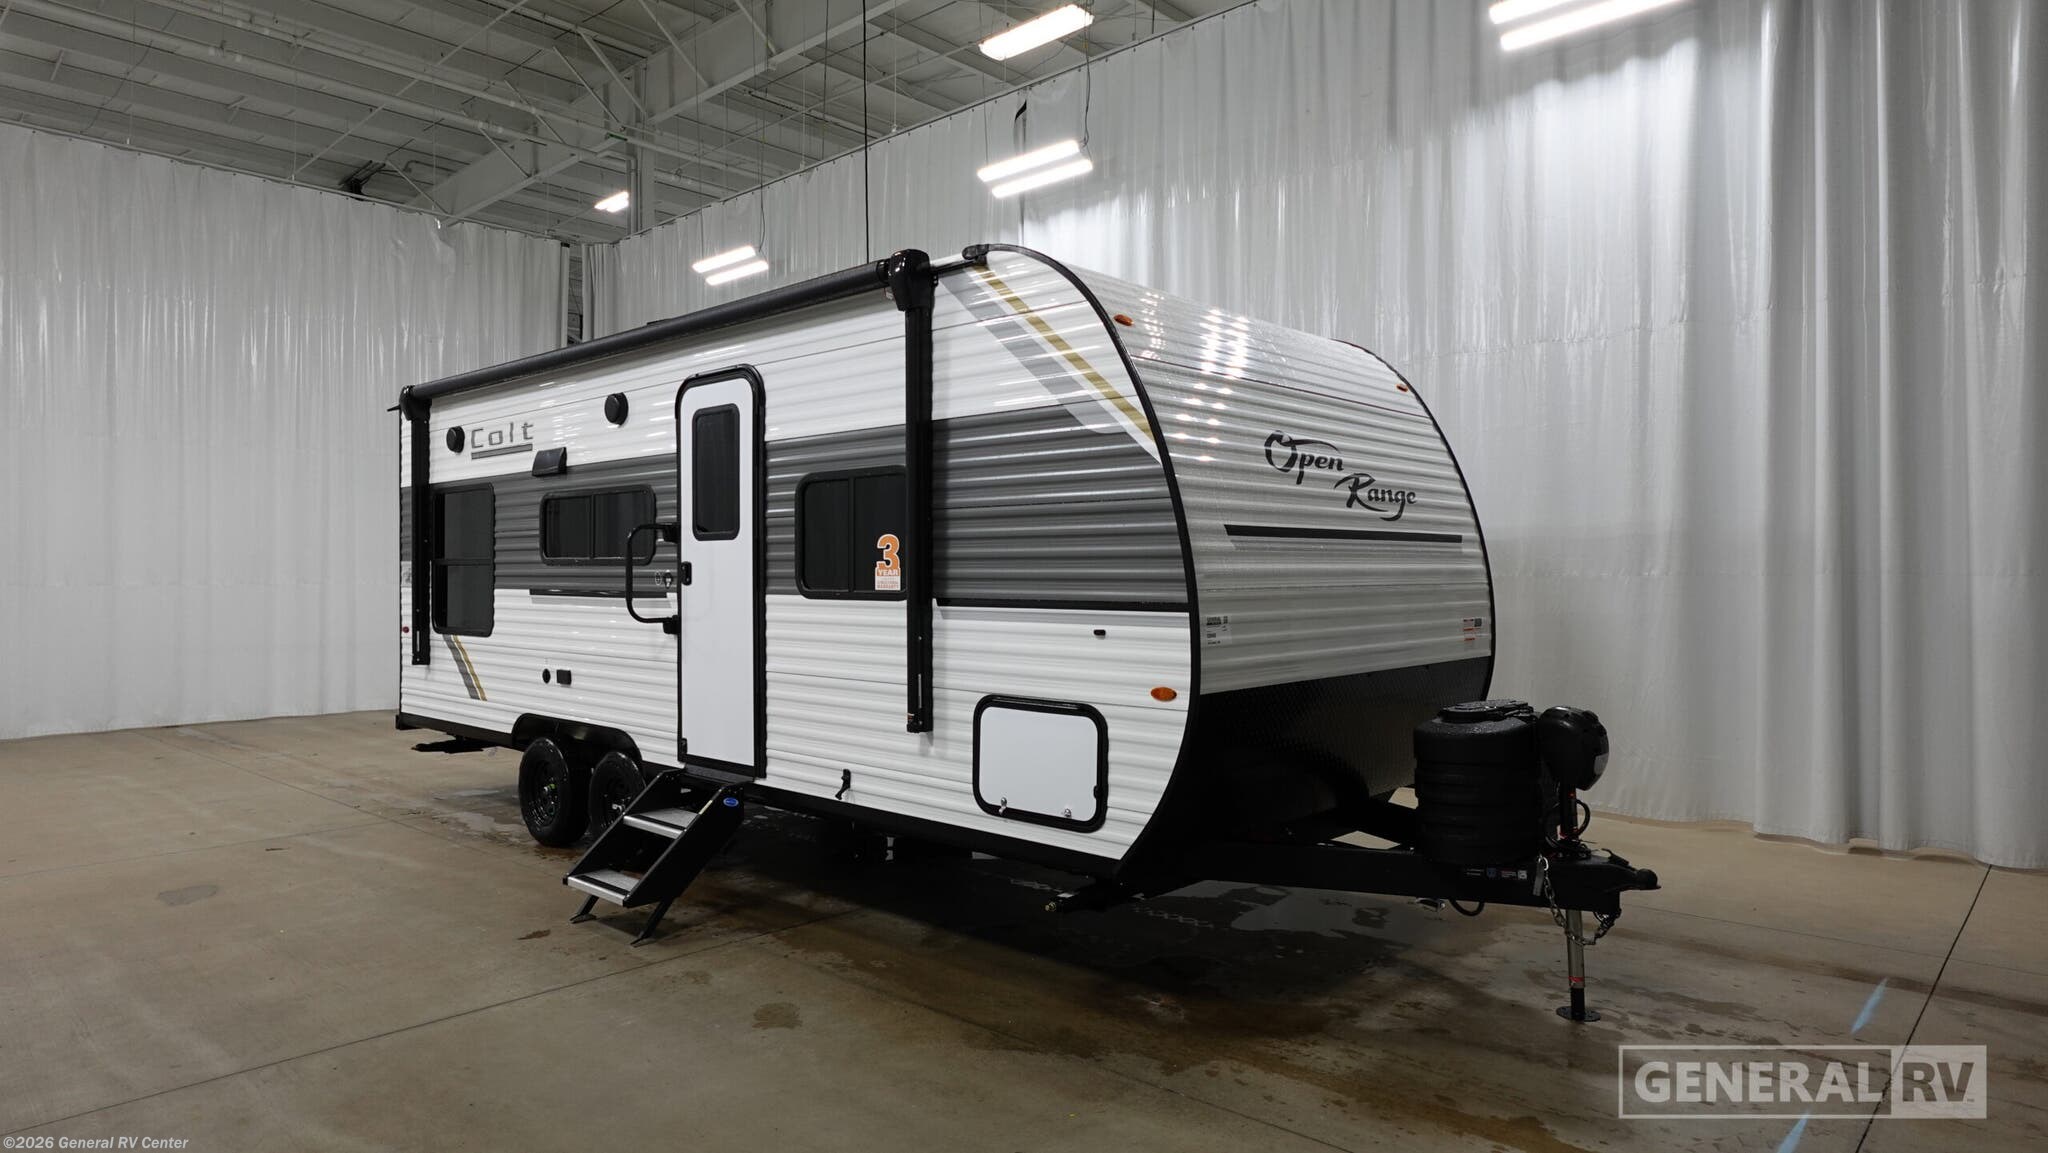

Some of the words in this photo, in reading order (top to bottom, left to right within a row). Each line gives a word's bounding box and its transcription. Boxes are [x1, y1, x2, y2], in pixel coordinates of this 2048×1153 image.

[471, 422, 533, 449] Colt
[1264, 430, 1344, 485] Open
[1334, 473, 1417, 522] Range
[876, 534, 900, 569] 3
